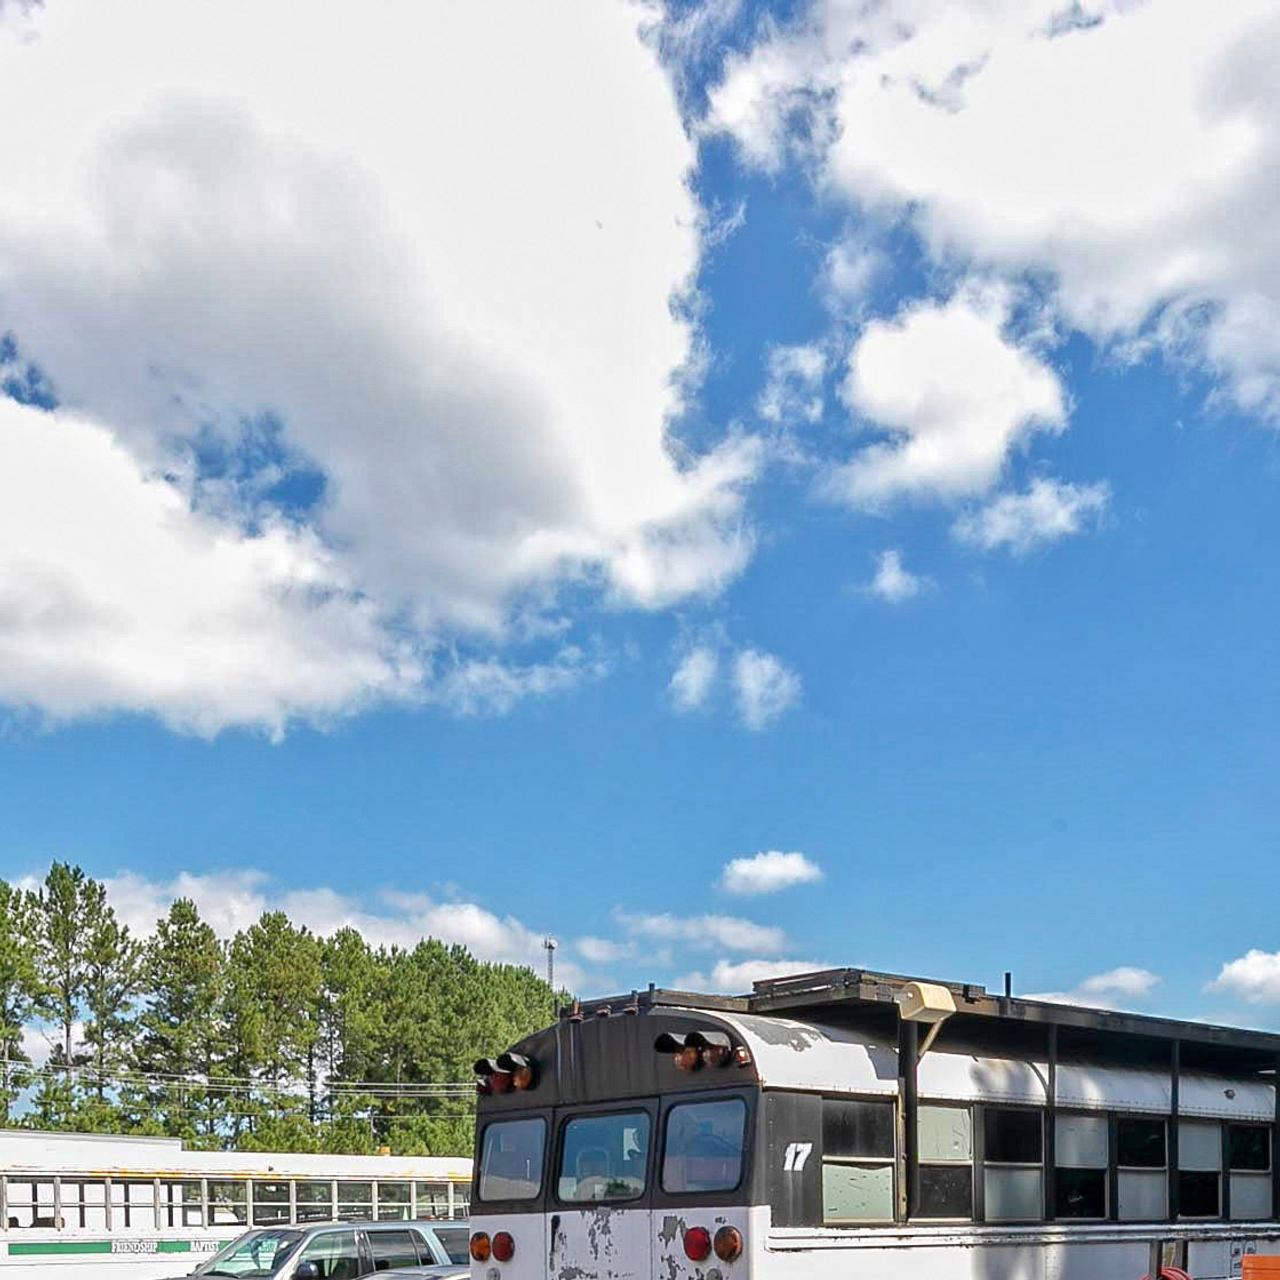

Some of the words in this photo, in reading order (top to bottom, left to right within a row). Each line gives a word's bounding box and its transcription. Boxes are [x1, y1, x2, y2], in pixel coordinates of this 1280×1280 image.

[783, 1142, 813, 1171] 17
[111, 1240, 158, 1253] FRIENDSHIP
[190, 1239, 220, 1252] BAPTIST
